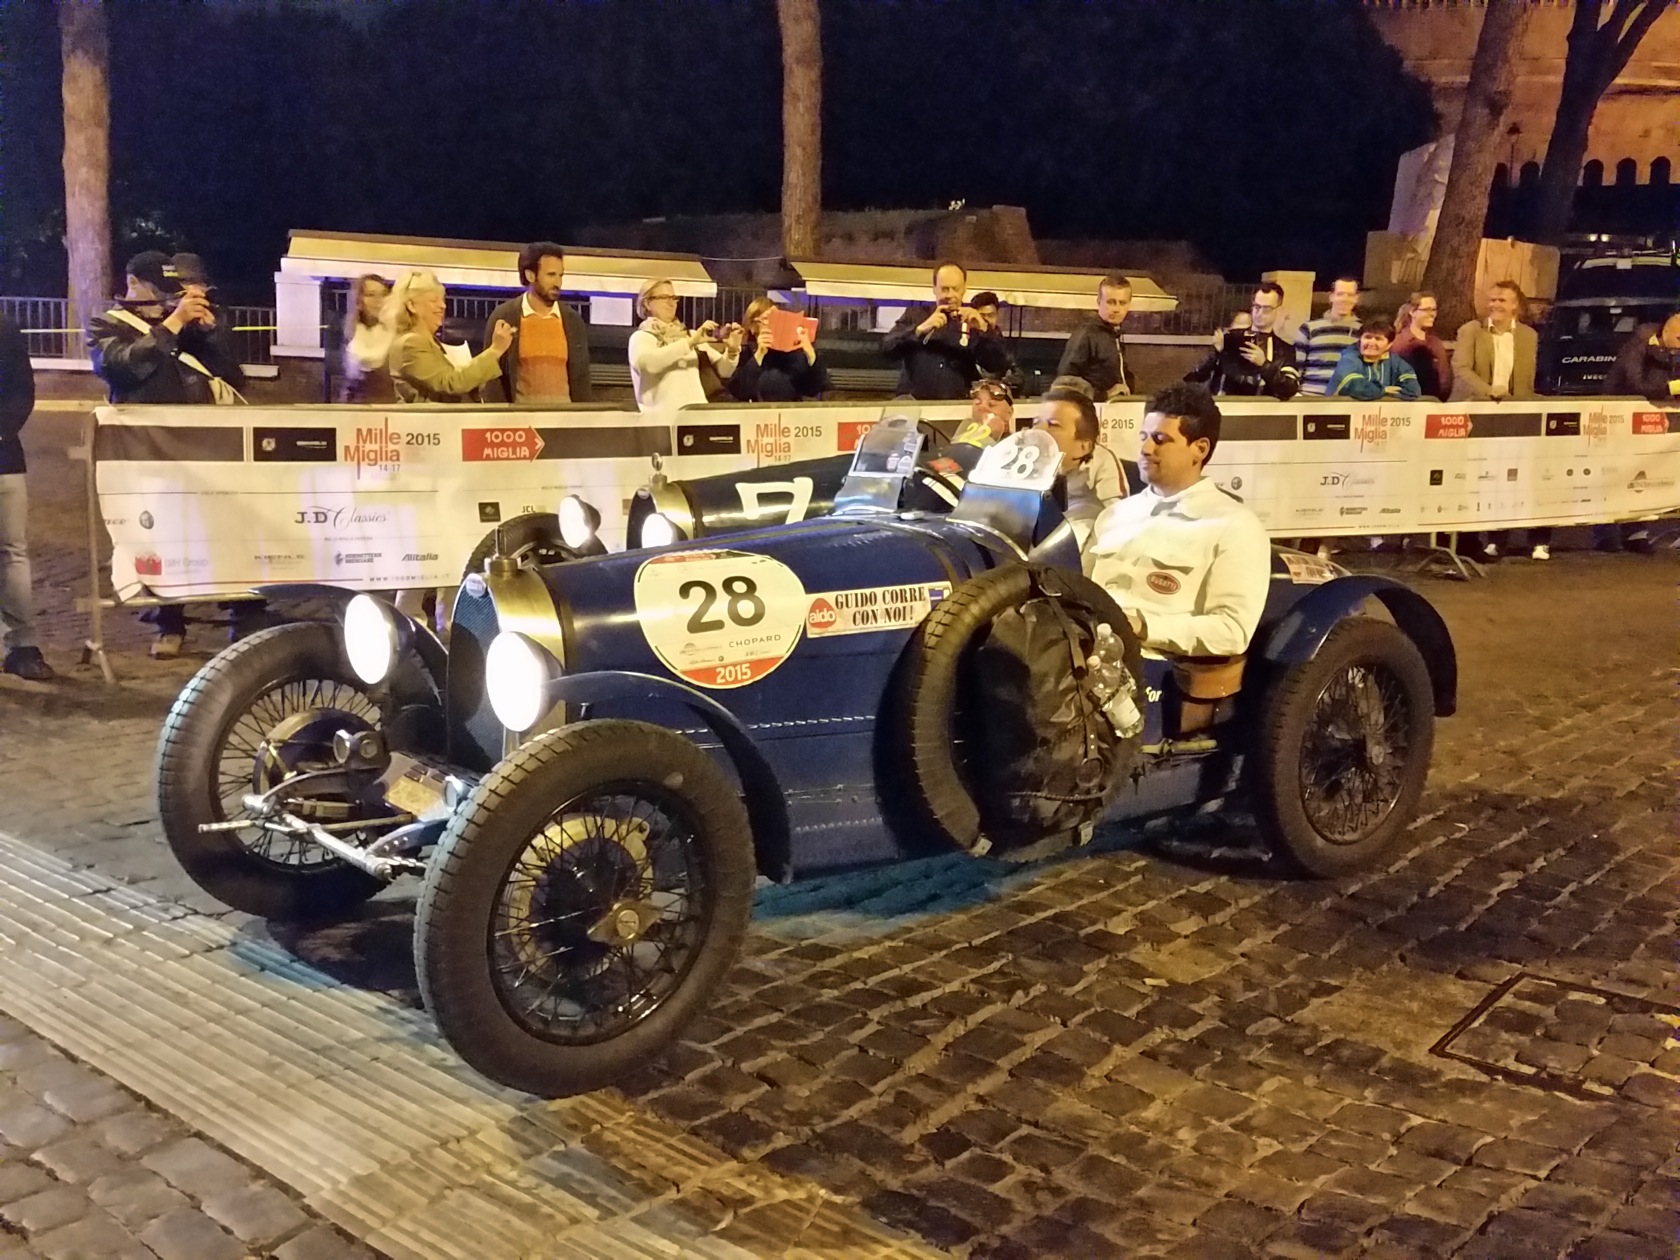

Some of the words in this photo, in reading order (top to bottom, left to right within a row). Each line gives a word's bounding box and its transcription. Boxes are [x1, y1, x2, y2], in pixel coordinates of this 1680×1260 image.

[756, 412, 791, 439] Mille
[794, 426, 822, 438] 2015
[1111, 418, 1135, 430] 2015
[1362, 406, 1388, 427] Mille
[1390, 417, 1411, 427] 2015
[1440, 416, 1465, 425] 1000
[1609, 415, 1624, 424] 2015
[355, 417, 401, 446] Mille
[405, 433, 441, 446] 2015
[485, 431, 526, 443] 1000
[1354, 427, 1388, 453] Miglia
[1437, 428, 1466, 438] MIGLIA
[344, 445, 400, 480] Miglia
[483, 446, 530, 459] MIGLIA
[746, 438, 791, 468] Miglia
[990, 441, 1040, 480] 28
[332, 505, 388, 531] Classics
[401, 552, 439, 562] Alitalia
[678, 575, 766, 634] 28
[835, 590, 878, 610] GUIDO
[882, 586, 926, 605] CORRE
[809, 608, 836, 624] aido
[852, 608, 879, 627] CON
[728, 634, 782, 648] CHOPARD
[715, 663, 751, 684] 2015
